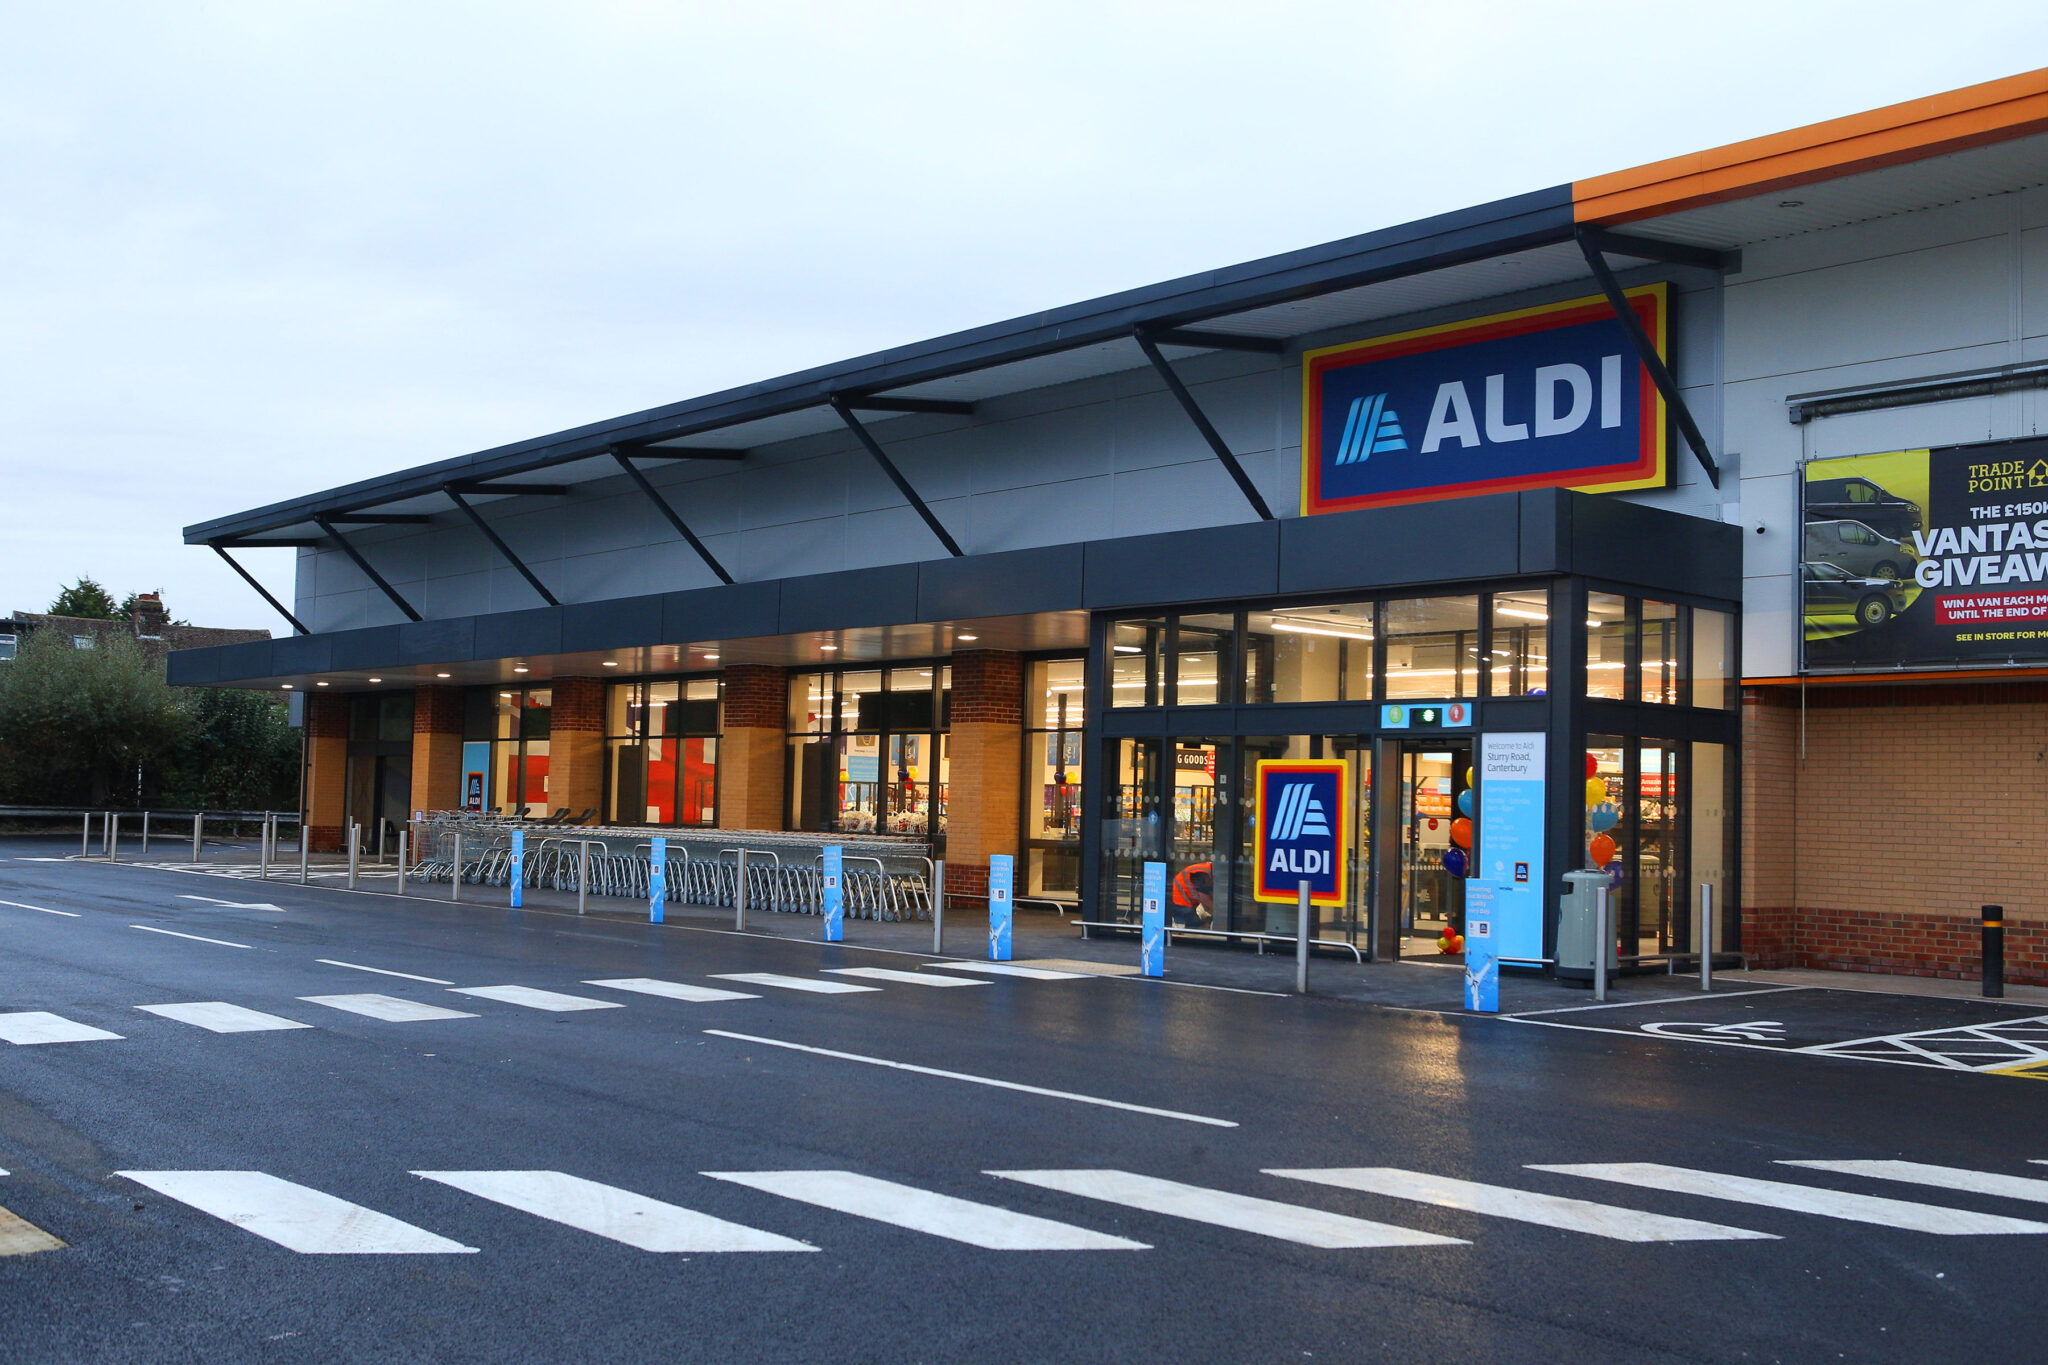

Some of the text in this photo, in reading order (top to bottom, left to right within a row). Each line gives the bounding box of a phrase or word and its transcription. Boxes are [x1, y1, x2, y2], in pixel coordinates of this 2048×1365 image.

[1420, 354, 1622, 453] ALDI
[1968, 460, 2025, 479] TRADE
[1968, 475, 2025, 493] POINT
[1969, 505, 2001, 519] THE
[1911, 520, 2048, 557] VANTAS
[1914, 552, 2048, 588] GIVEAW
[1942, 594, 2048, 609] WIN A VAN EACH M
[1948, 606, 2048, 620] UNTIL THE END OF
[1955, 630, 2048, 642] SEE IN STORE FOR M
[1184, 754, 1208, 765] GOODS
[1487, 752, 1510, 763] Sturry
[1487, 763, 1528, 774] Canterbury
[1269, 848, 1330, 875] ALDI
